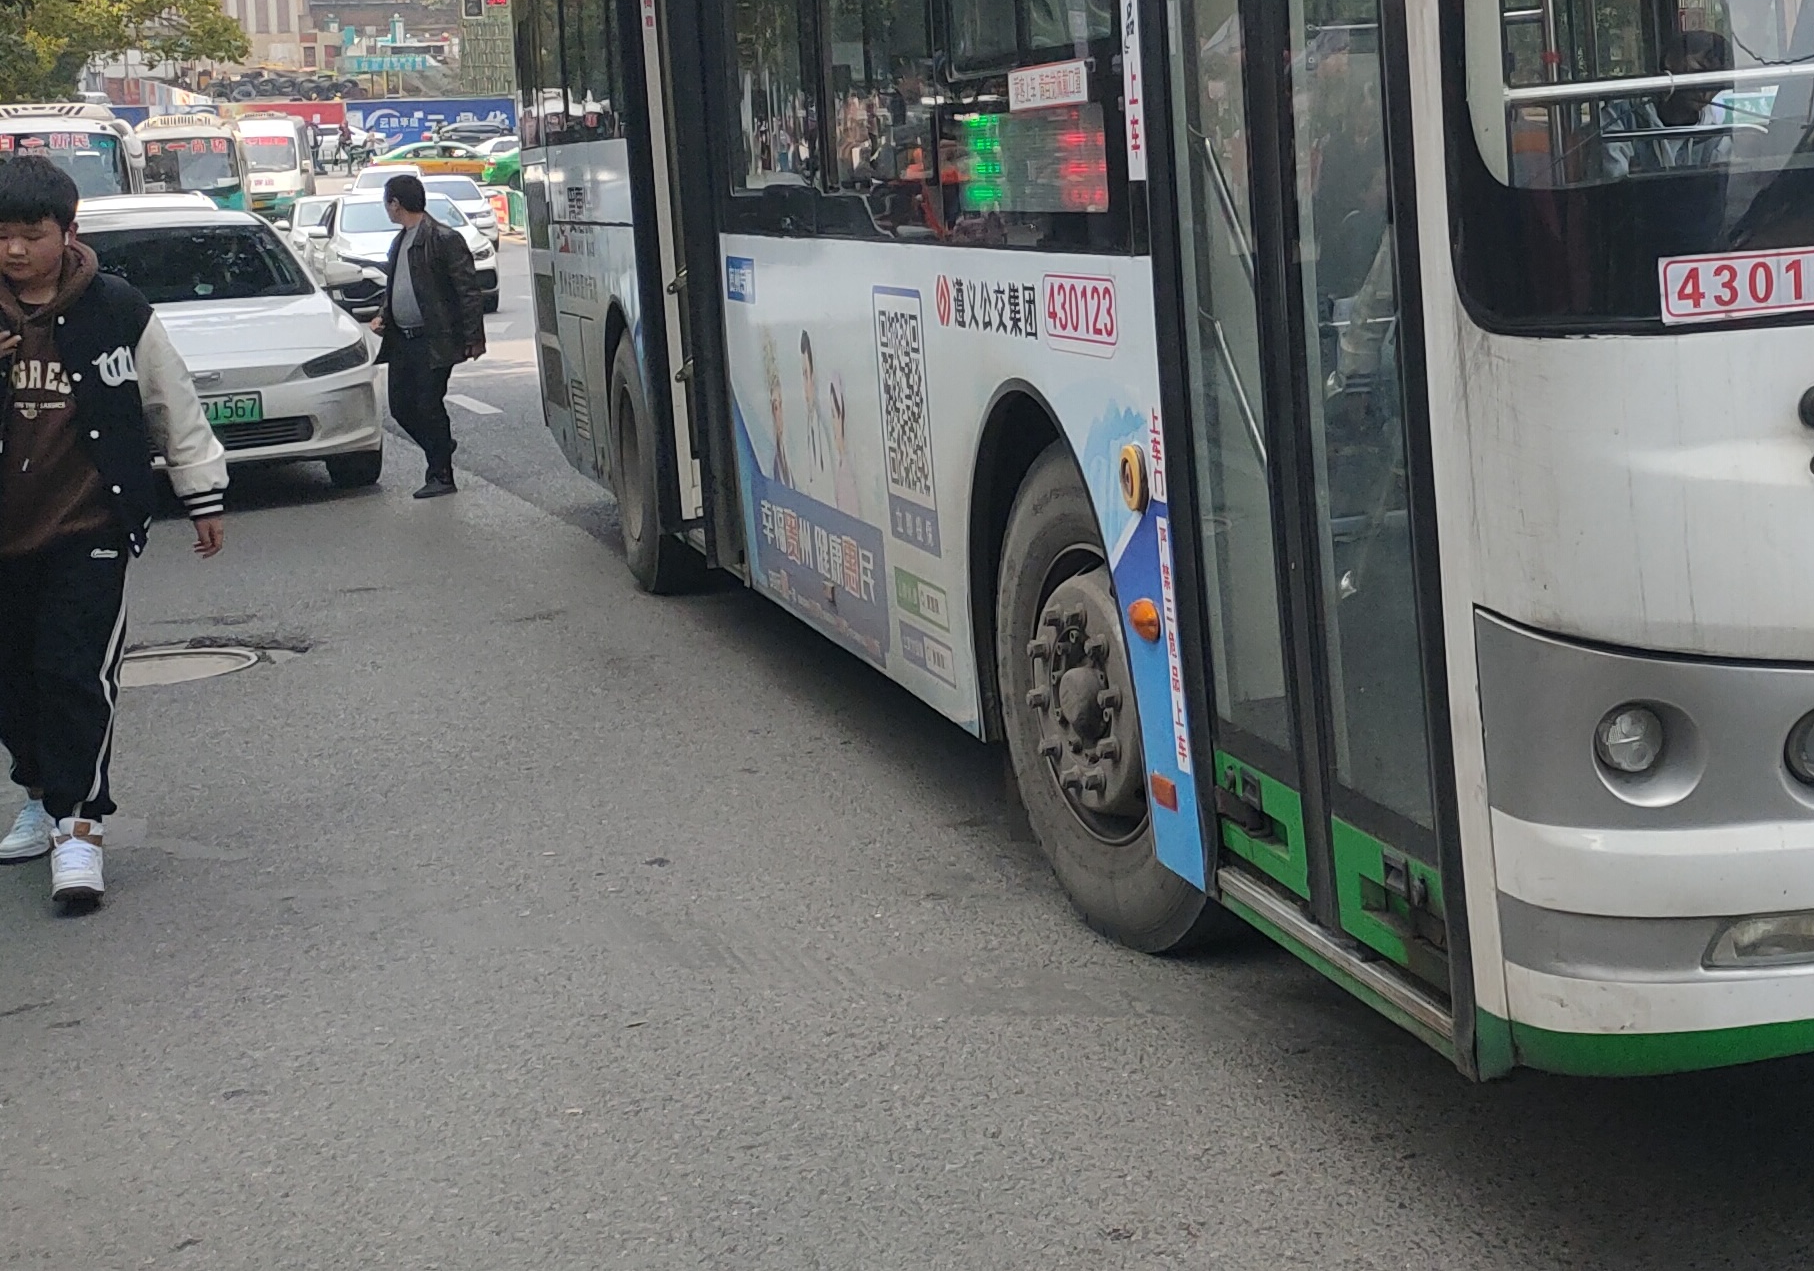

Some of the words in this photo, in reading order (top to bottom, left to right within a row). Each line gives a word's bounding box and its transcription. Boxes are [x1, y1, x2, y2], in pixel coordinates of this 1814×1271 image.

[951, 276, 1039, 341] 遵义公交集团
[1047, 281, 1115, 338] 430123
